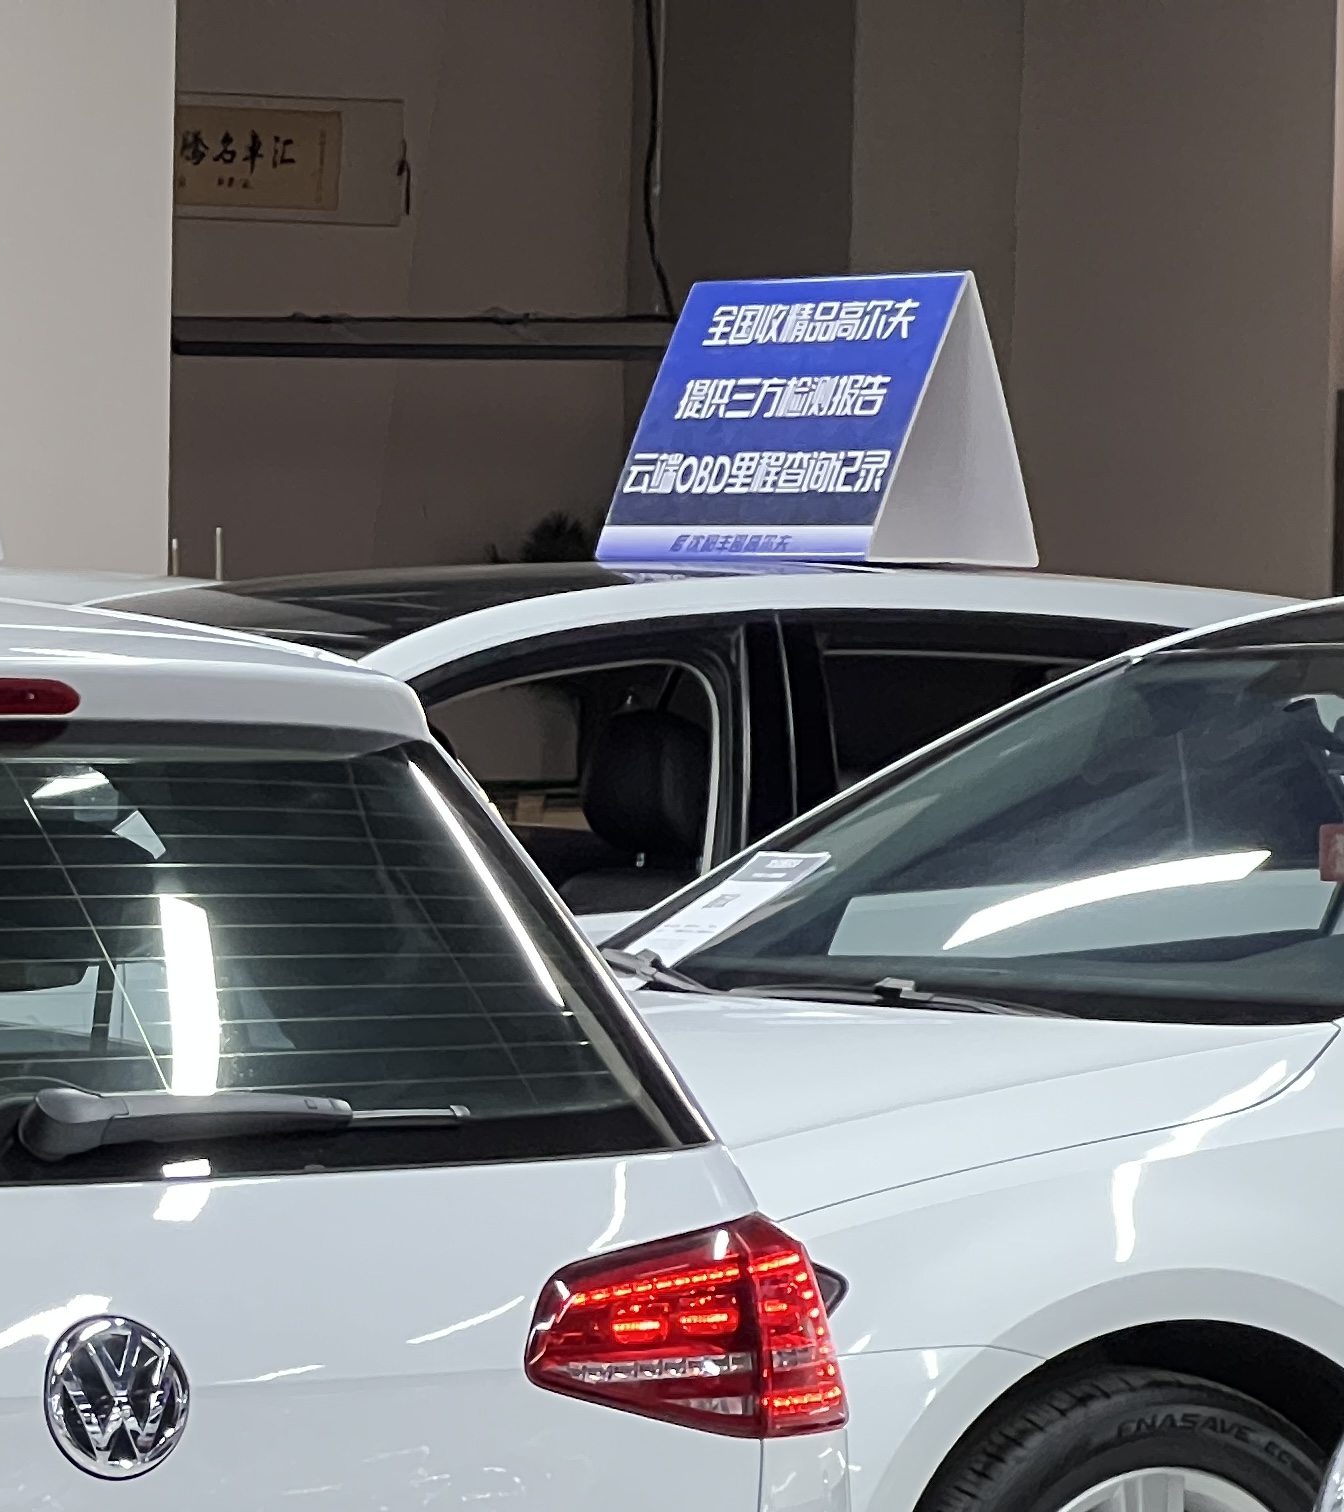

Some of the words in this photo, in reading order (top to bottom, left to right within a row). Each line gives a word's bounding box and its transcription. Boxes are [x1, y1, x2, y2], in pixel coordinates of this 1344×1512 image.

[701, 298, 920, 347] 全国收精品高尔夫
[674, 375, 891, 420] 提供三方检测报告
[623, 449, 892, 495] 云端OBD里程查询记录
